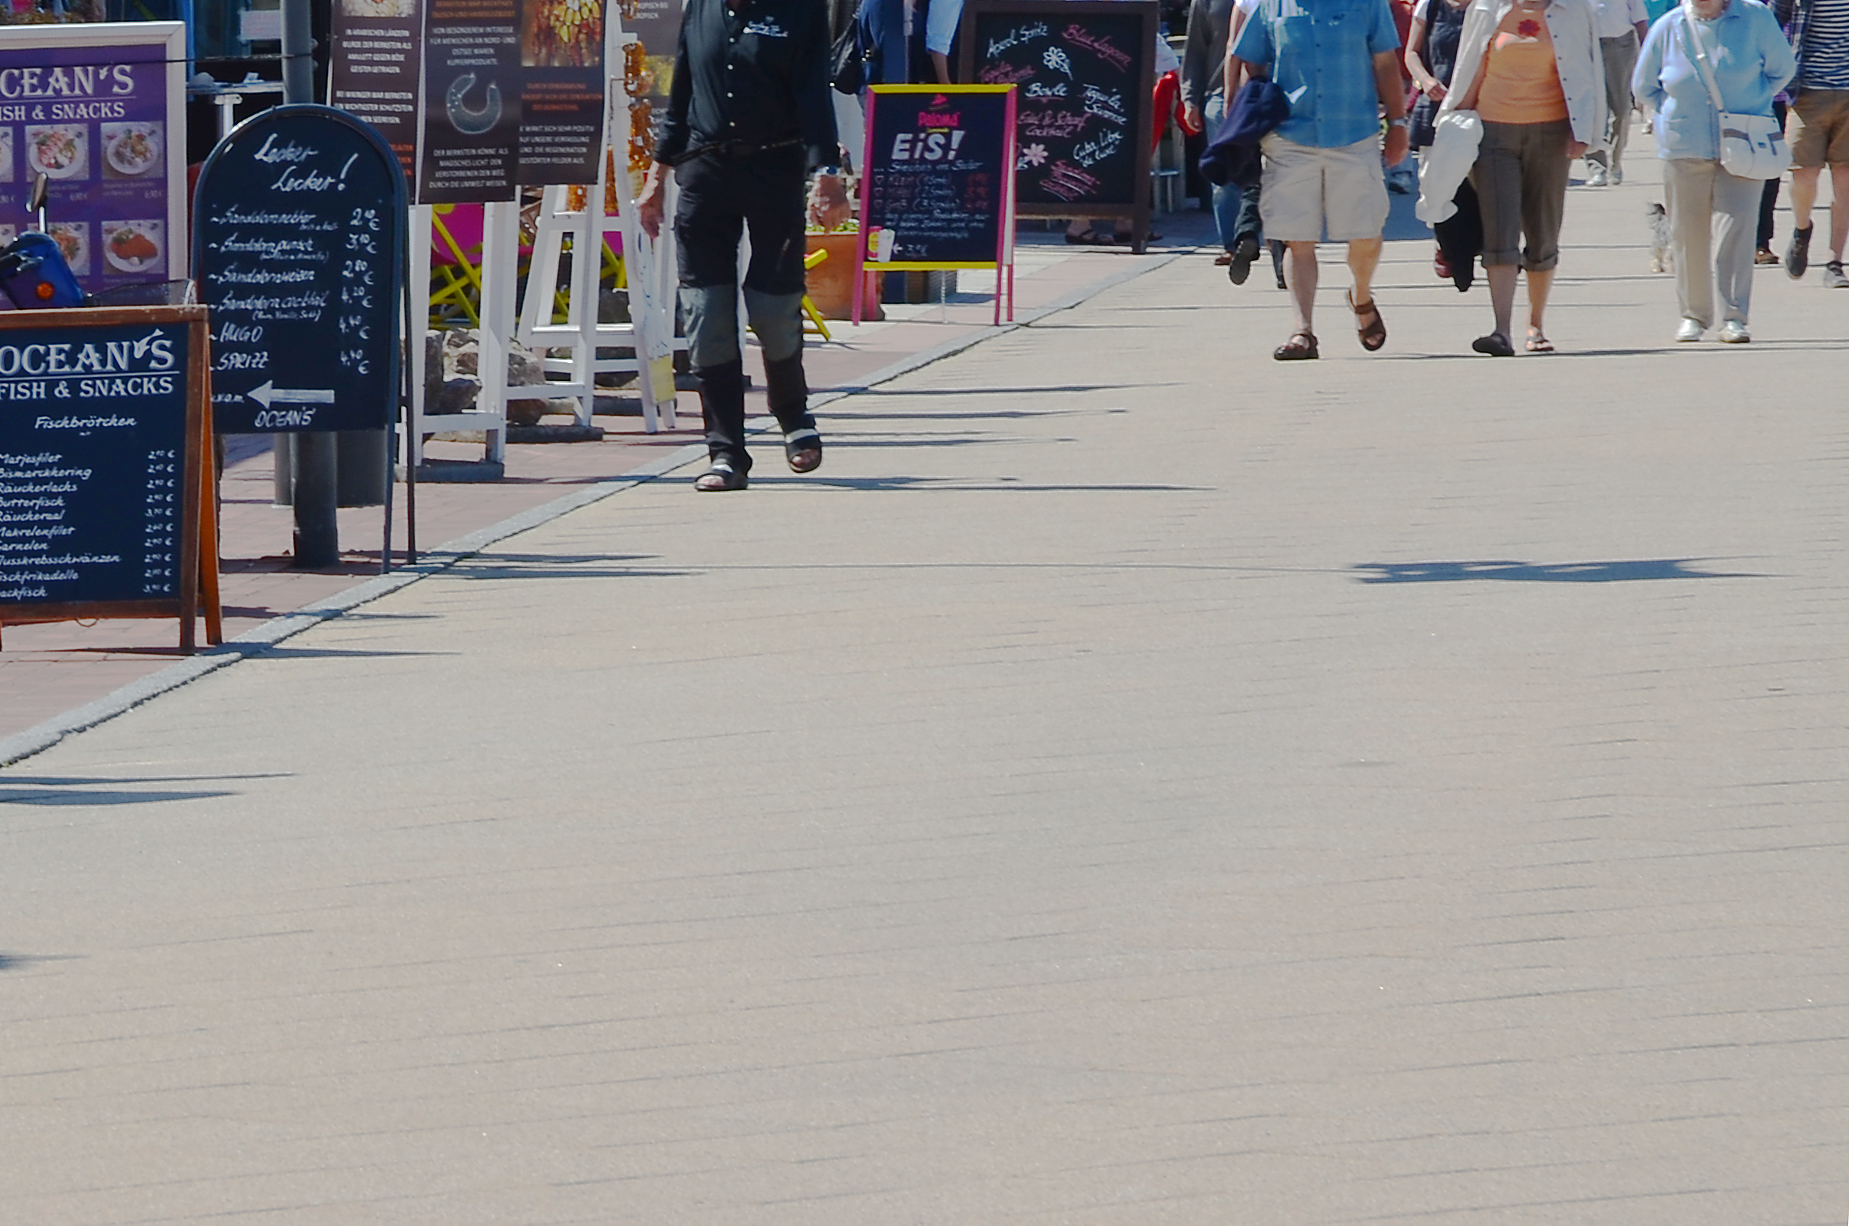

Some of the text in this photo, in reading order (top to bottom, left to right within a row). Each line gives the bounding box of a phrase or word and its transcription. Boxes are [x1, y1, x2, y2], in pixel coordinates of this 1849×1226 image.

[32, 105, 45, 120] &
[52, 102, 125, 119] SNACKS
[254, 133, 318, 163] Lecker
[220, 322, 263, 342] HUGO
[54, 381, 71, 397] &
[80, 377, 174, 396] SNACKS
[35, 414, 137, 429] Fischbrötchen
